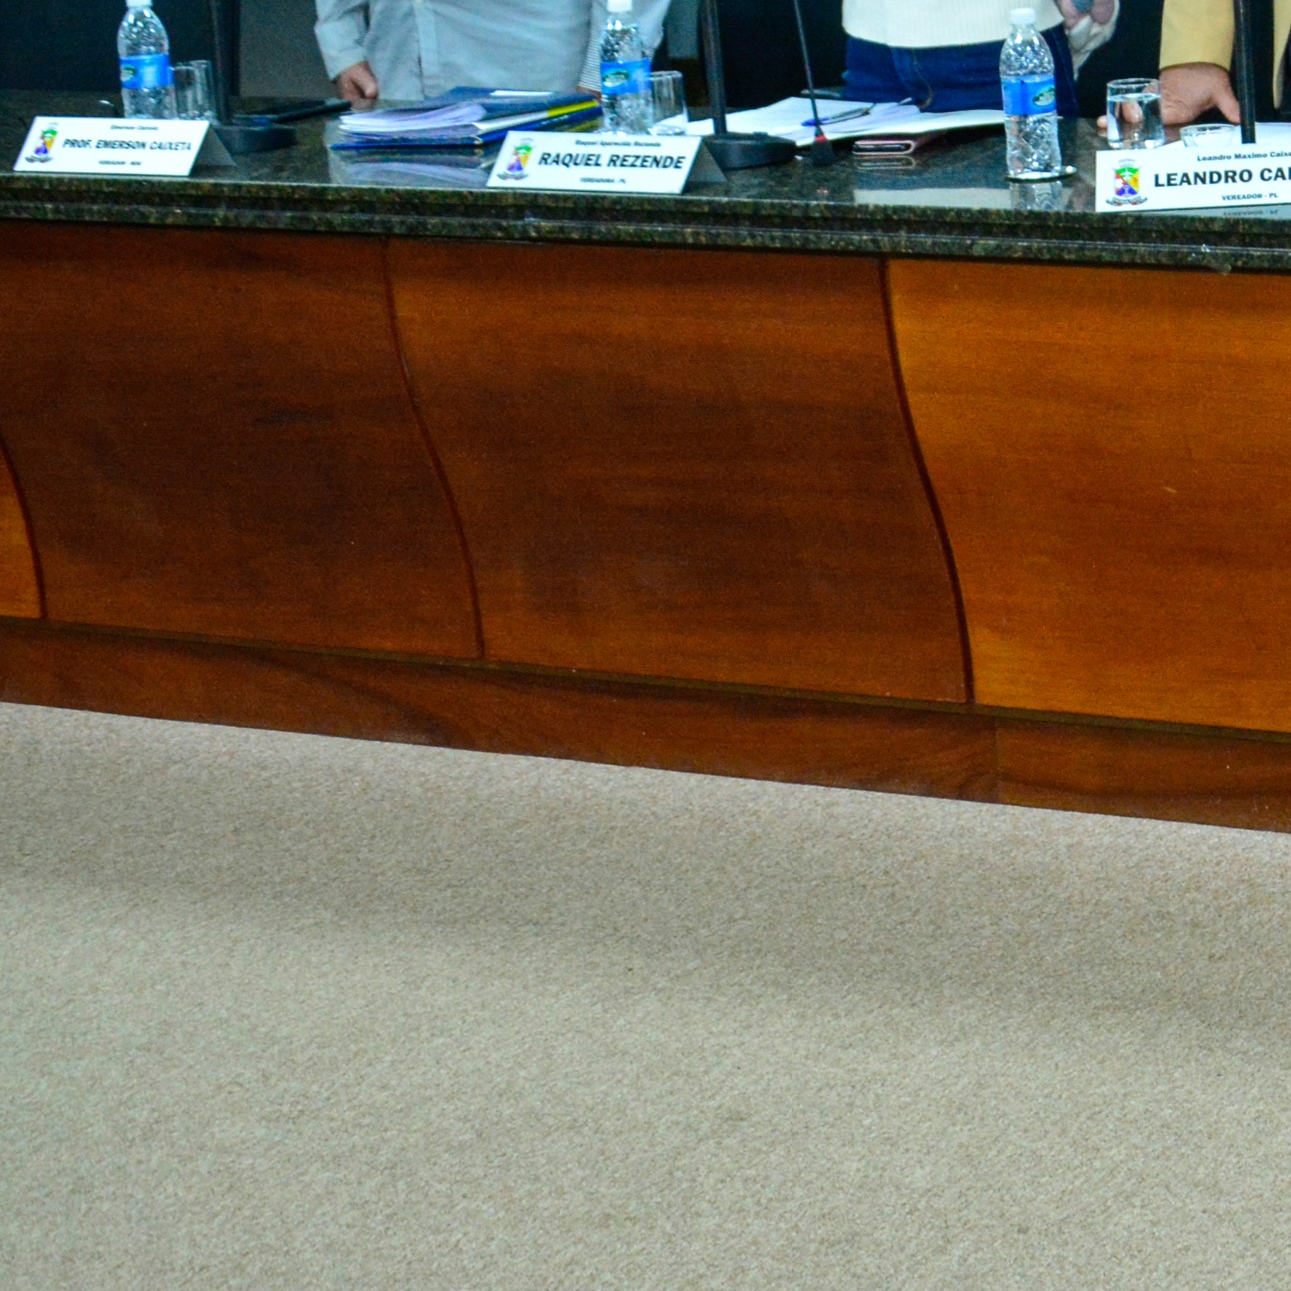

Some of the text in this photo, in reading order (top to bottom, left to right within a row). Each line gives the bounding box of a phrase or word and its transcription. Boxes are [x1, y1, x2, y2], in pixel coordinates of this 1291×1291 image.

[62, 139, 191, 151] PROF. EMERSON CAIXETA
[538, 153, 686, 169] RAQUEL REZENDE
[1197, 154, 1232, 162] Leandro
[1234, 152, 1268, 160] Maximo
[1154, 169, 1254, 188] LEANDRO
